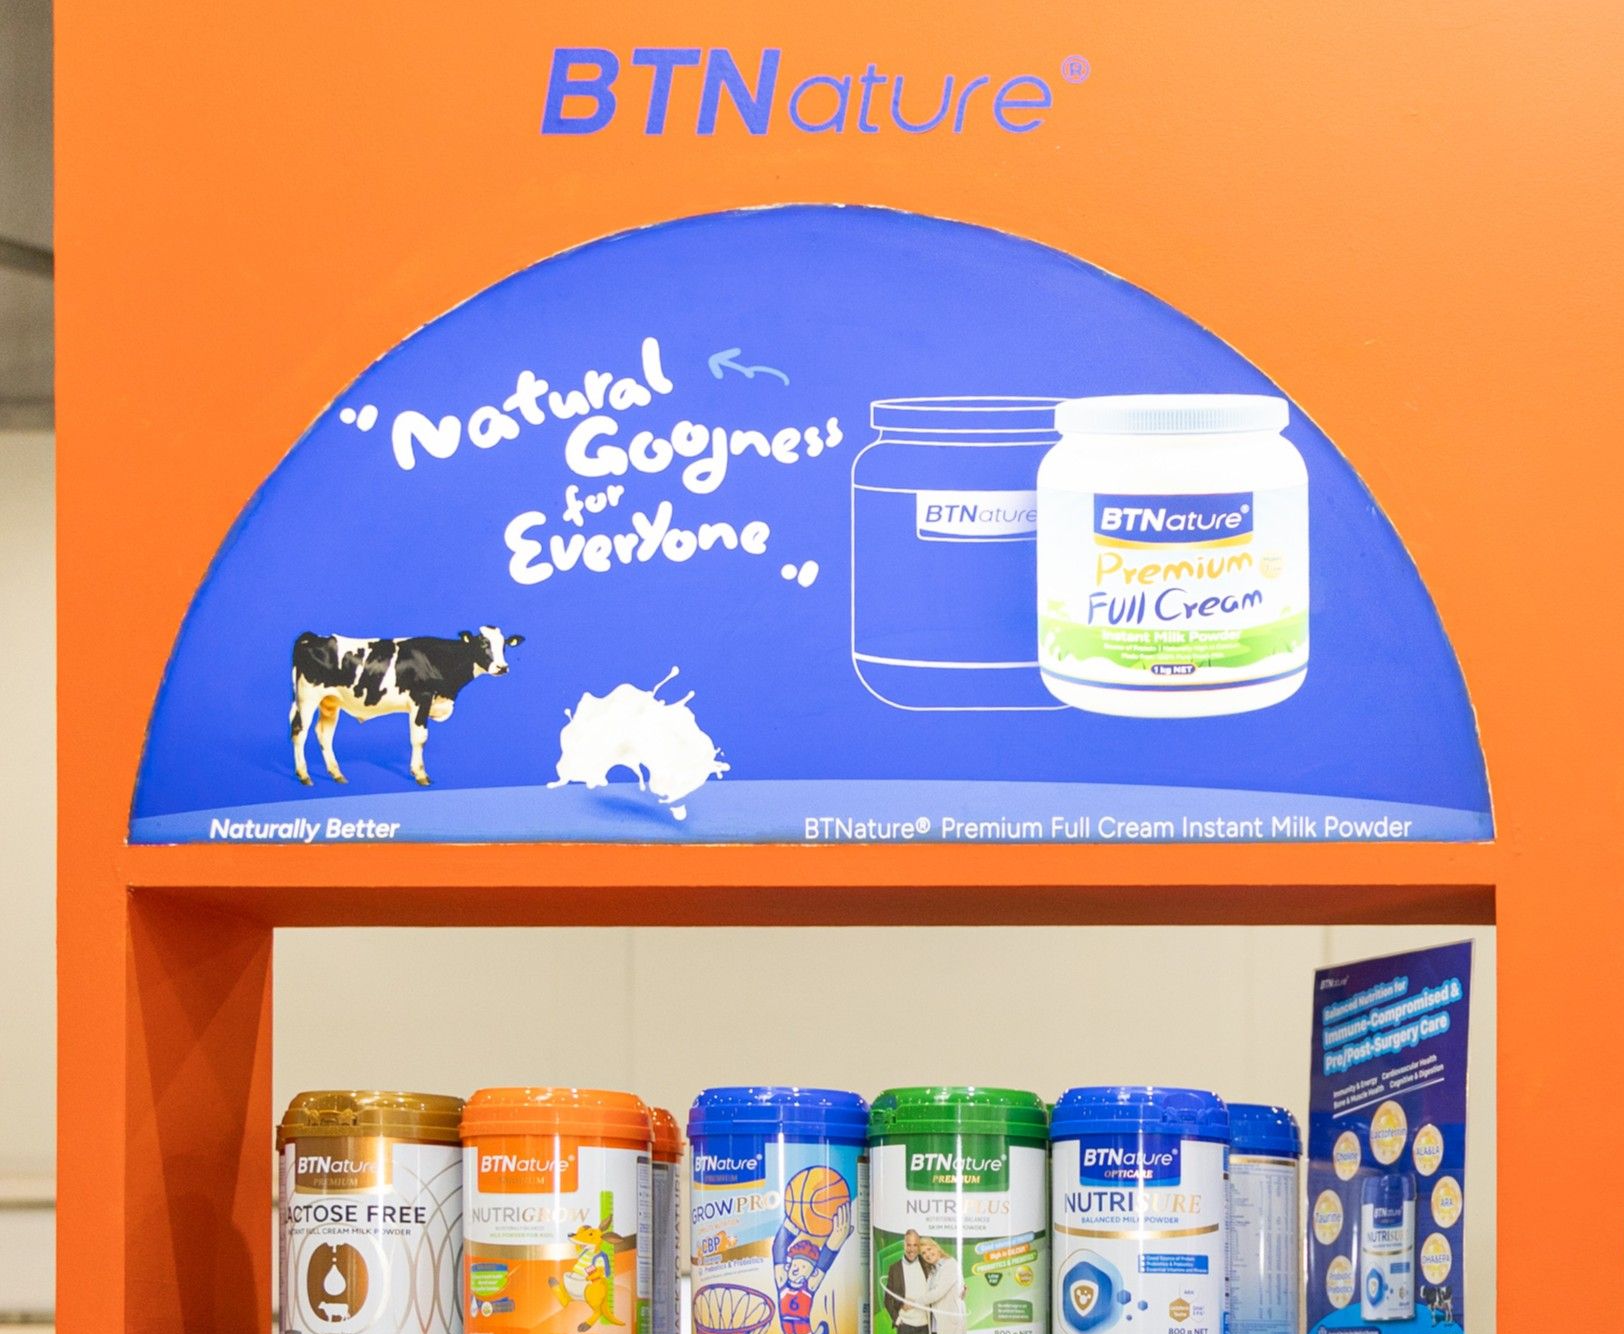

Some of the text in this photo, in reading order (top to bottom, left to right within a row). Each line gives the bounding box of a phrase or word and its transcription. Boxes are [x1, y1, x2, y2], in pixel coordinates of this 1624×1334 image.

[563, 484, 624, 526] for
[1096, 552, 1253, 586] Premium
[1155, 587, 1263, 621] Cream
[209, 817, 400, 843] Naturally Better
[941, 817, 1043, 839] Premium
[1051, 817, 1090, 839] Full
[1098, 817, 1175, 839] Cream
[1183, 817, 1263, 839] Instant
[1271, 817, 1317, 839] Milk
[1325, 817, 1412, 839] Powder
[1324, 982, 1460, 1045] Immune-Compromised &
[1326, 1014, 1447, 1072] Pre/Post-Surgery Care
[286, 1205, 427, 1224] ACTOSE FREE
[789, 1297, 799, 1311] 6
